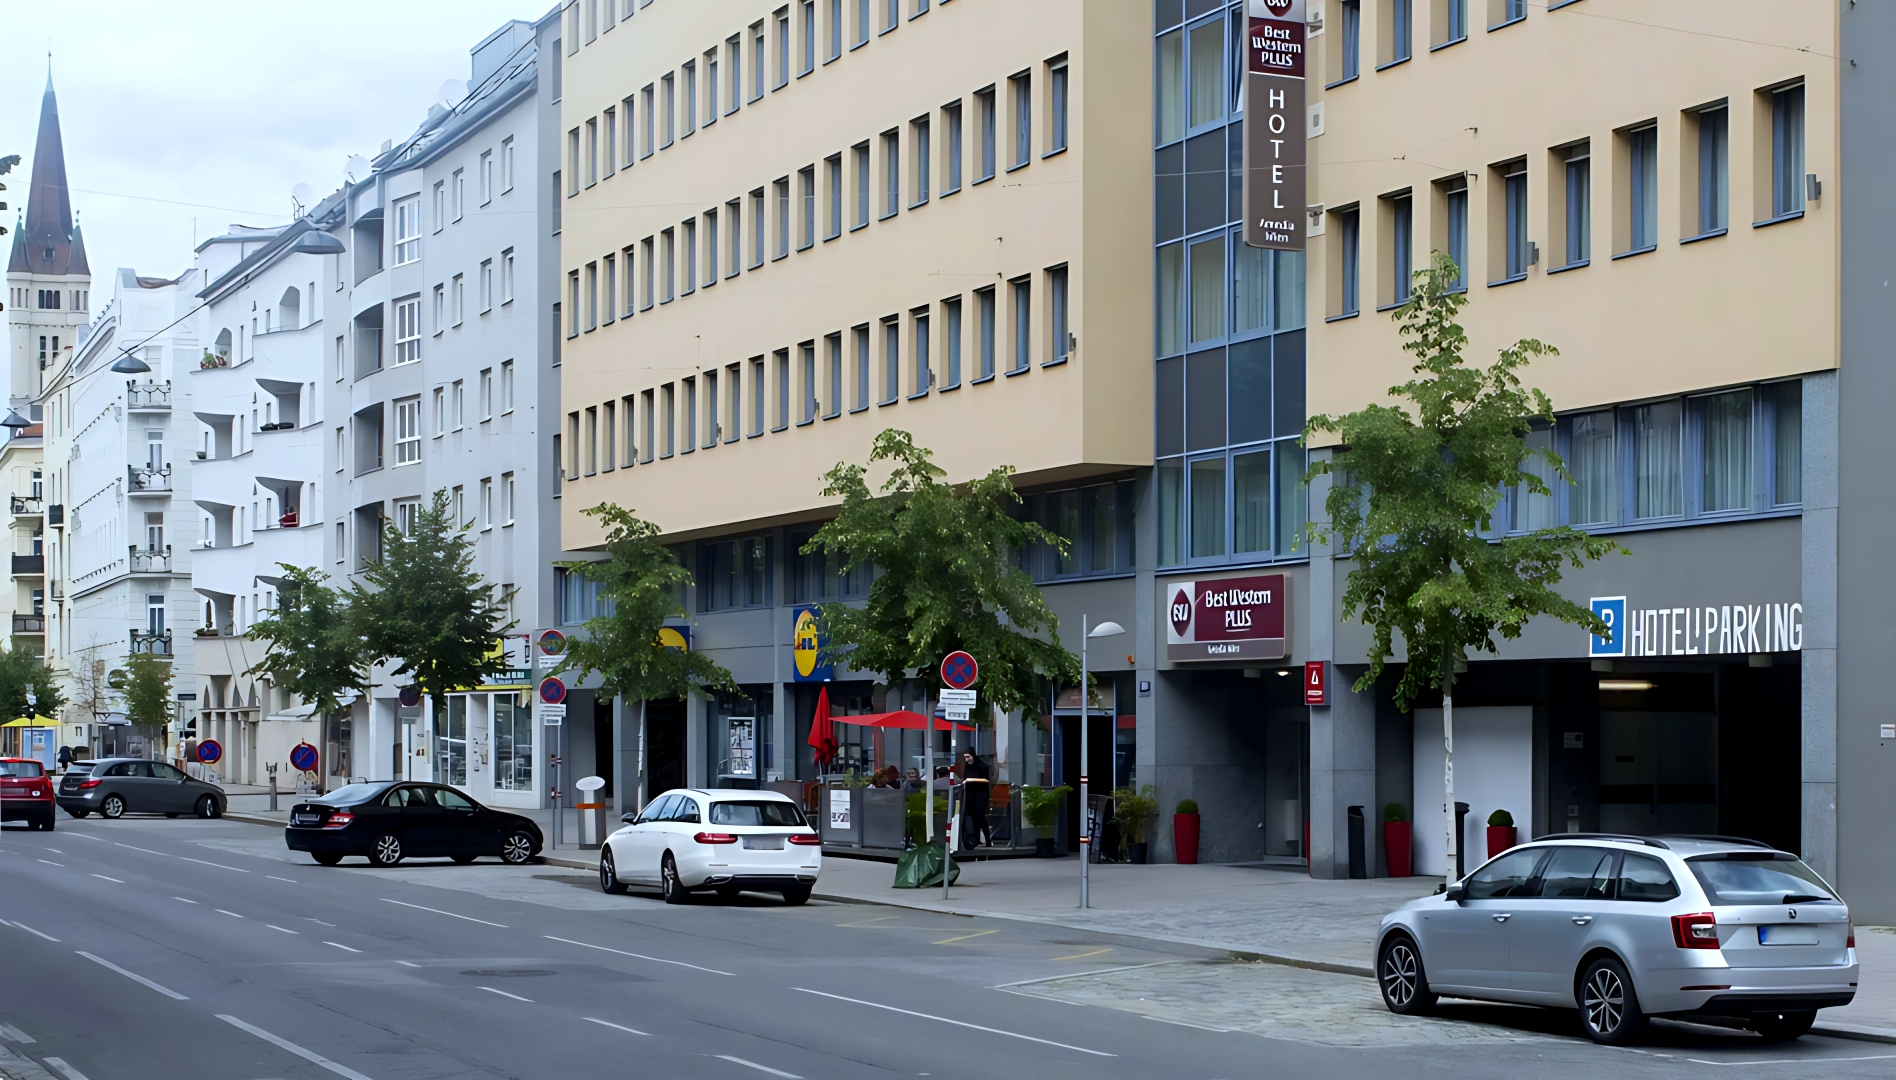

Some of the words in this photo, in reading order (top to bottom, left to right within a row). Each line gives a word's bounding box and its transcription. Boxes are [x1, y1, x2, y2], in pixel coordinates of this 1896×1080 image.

[1264, 25, 1291, 40] Best
[1261, 51, 1293, 66] PLUS
[1268, 88, 1285, 209] HOTEL
[1205, 590, 1228, 608] Best
[1225, 609, 1252, 628] PLUS
